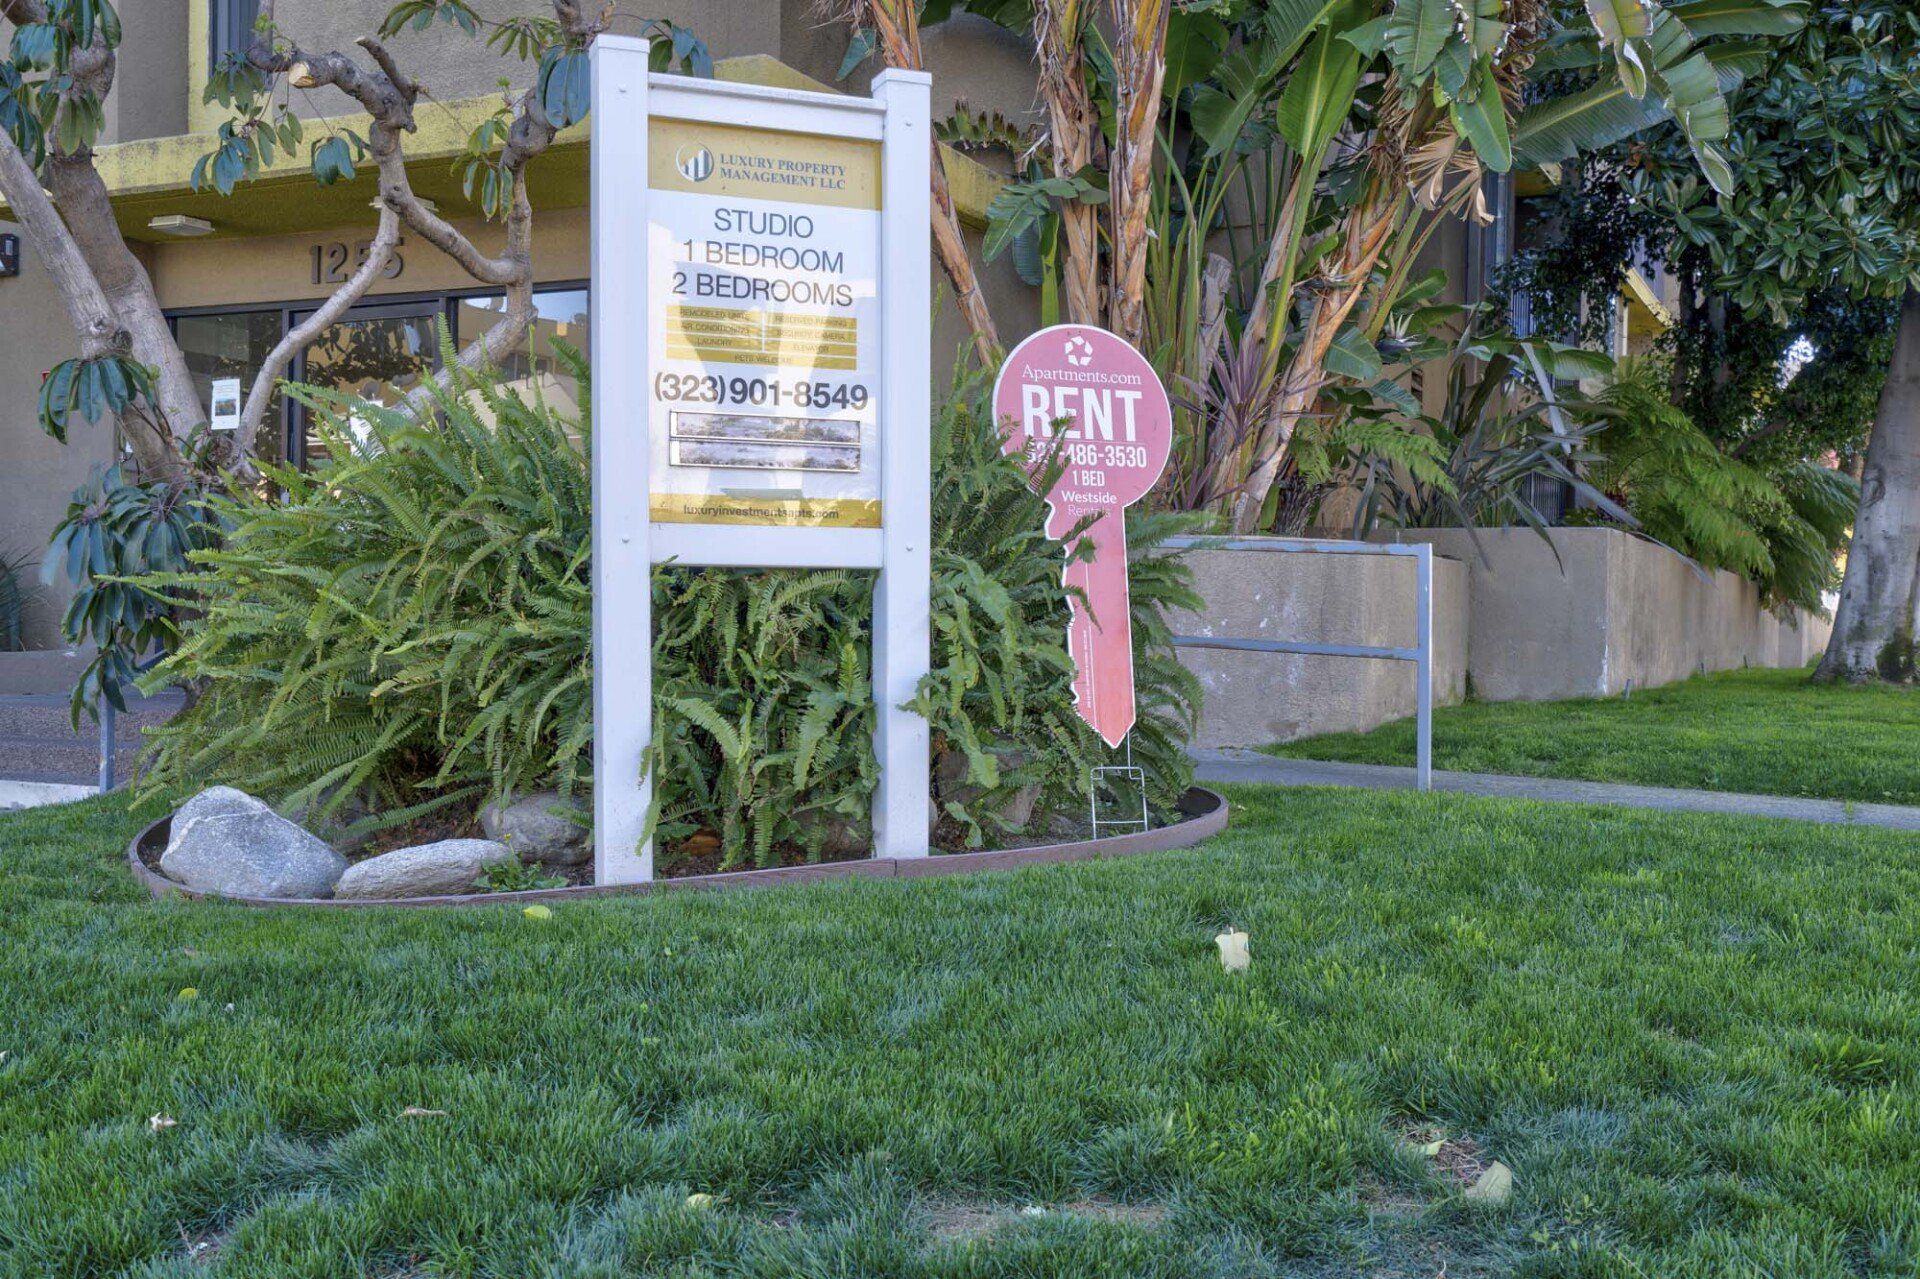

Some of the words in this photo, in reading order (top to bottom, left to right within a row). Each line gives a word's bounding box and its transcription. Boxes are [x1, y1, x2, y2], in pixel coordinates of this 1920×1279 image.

[720, 153, 776, 170] LUXURY
[778, 159, 846, 177] PROPERTY
[720, 167, 818, 188] MANAGEMENT
[819, 179, 846, 191] LLC
[714, 208, 814, 239] STUDIO
[683, 239, 693, 262] 1
[706, 240, 844, 274] BEDROOM
[672, 272, 688, 295] 2
[696, 273, 853, 308] BEDROOMS
[1022, 364, 1142, 385] Apartments.com
[655, 372, 869, 411] (323)901-8549
[1021, 384, 1143, 442] RENT
[1072, 470, 1078, 486] 1
[1082, 471, 1106, 487] BED
[1061, 490, 1117, 504] Westside
